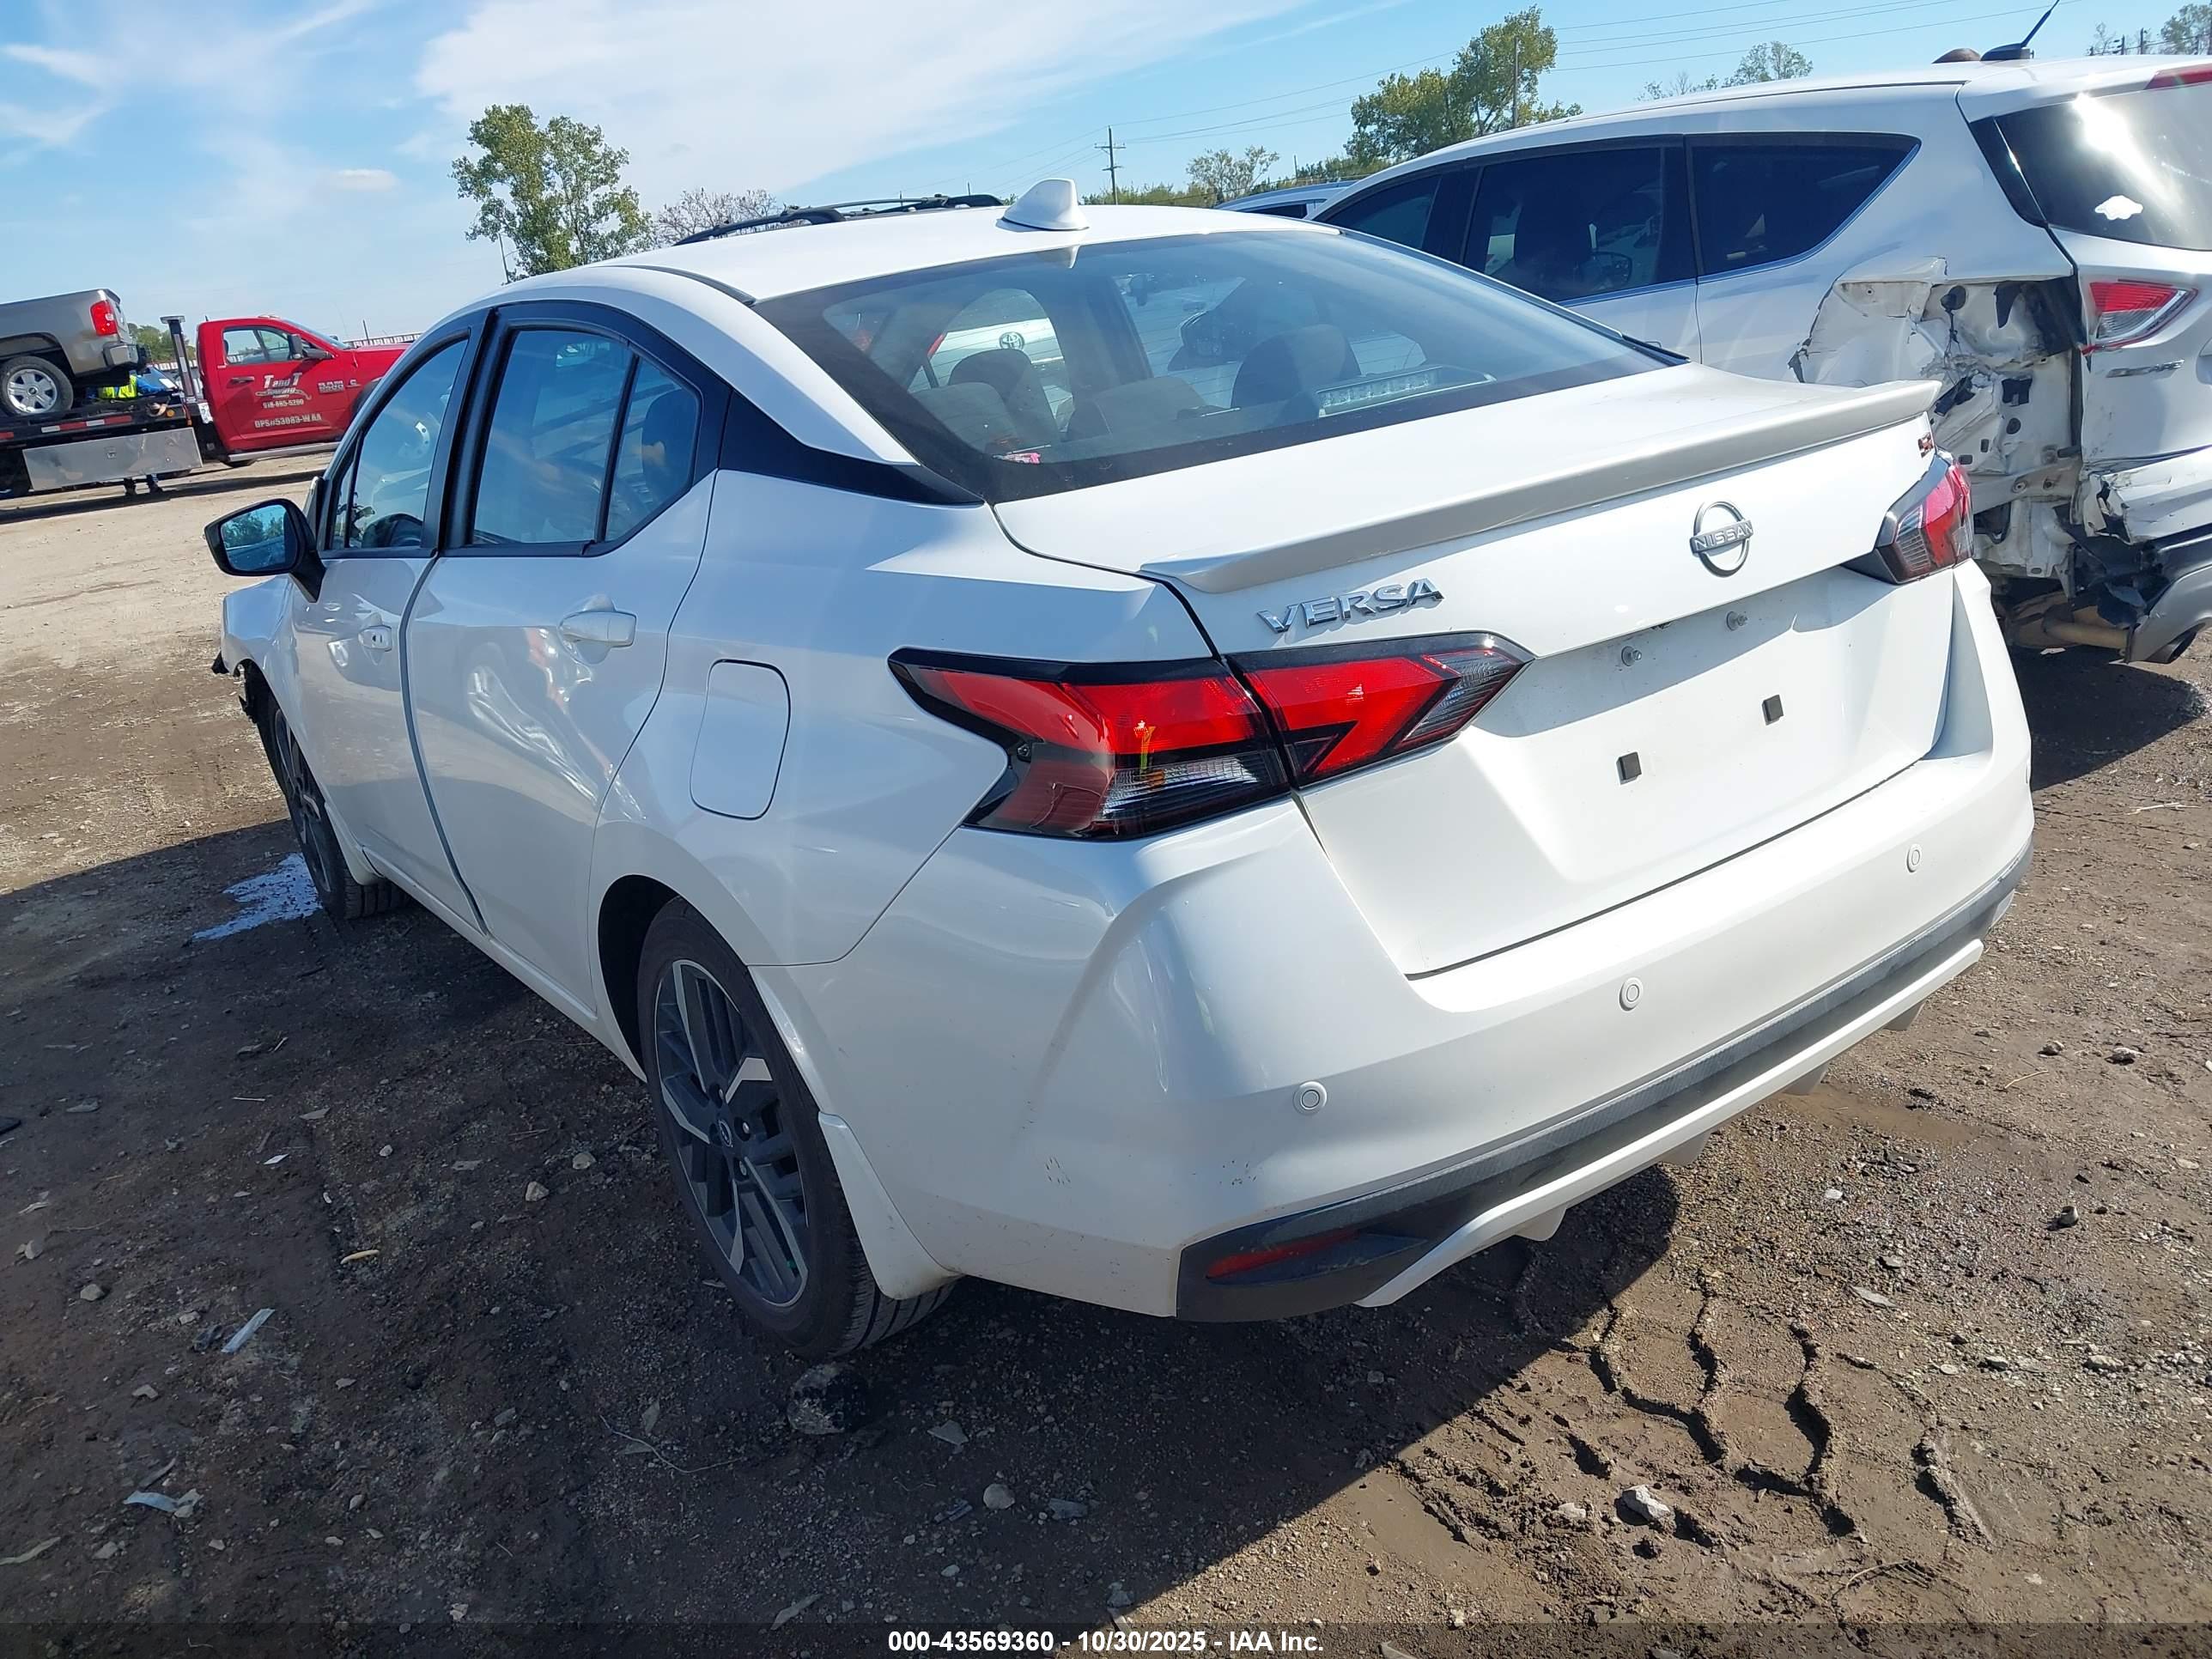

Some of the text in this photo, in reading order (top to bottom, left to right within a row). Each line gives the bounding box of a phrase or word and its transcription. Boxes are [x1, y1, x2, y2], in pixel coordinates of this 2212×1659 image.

[264, 373, 302, 388] T and T
[1695, 521, 1753, 550] NISSAN
[1256, 578, 1444, 634] VERSA
